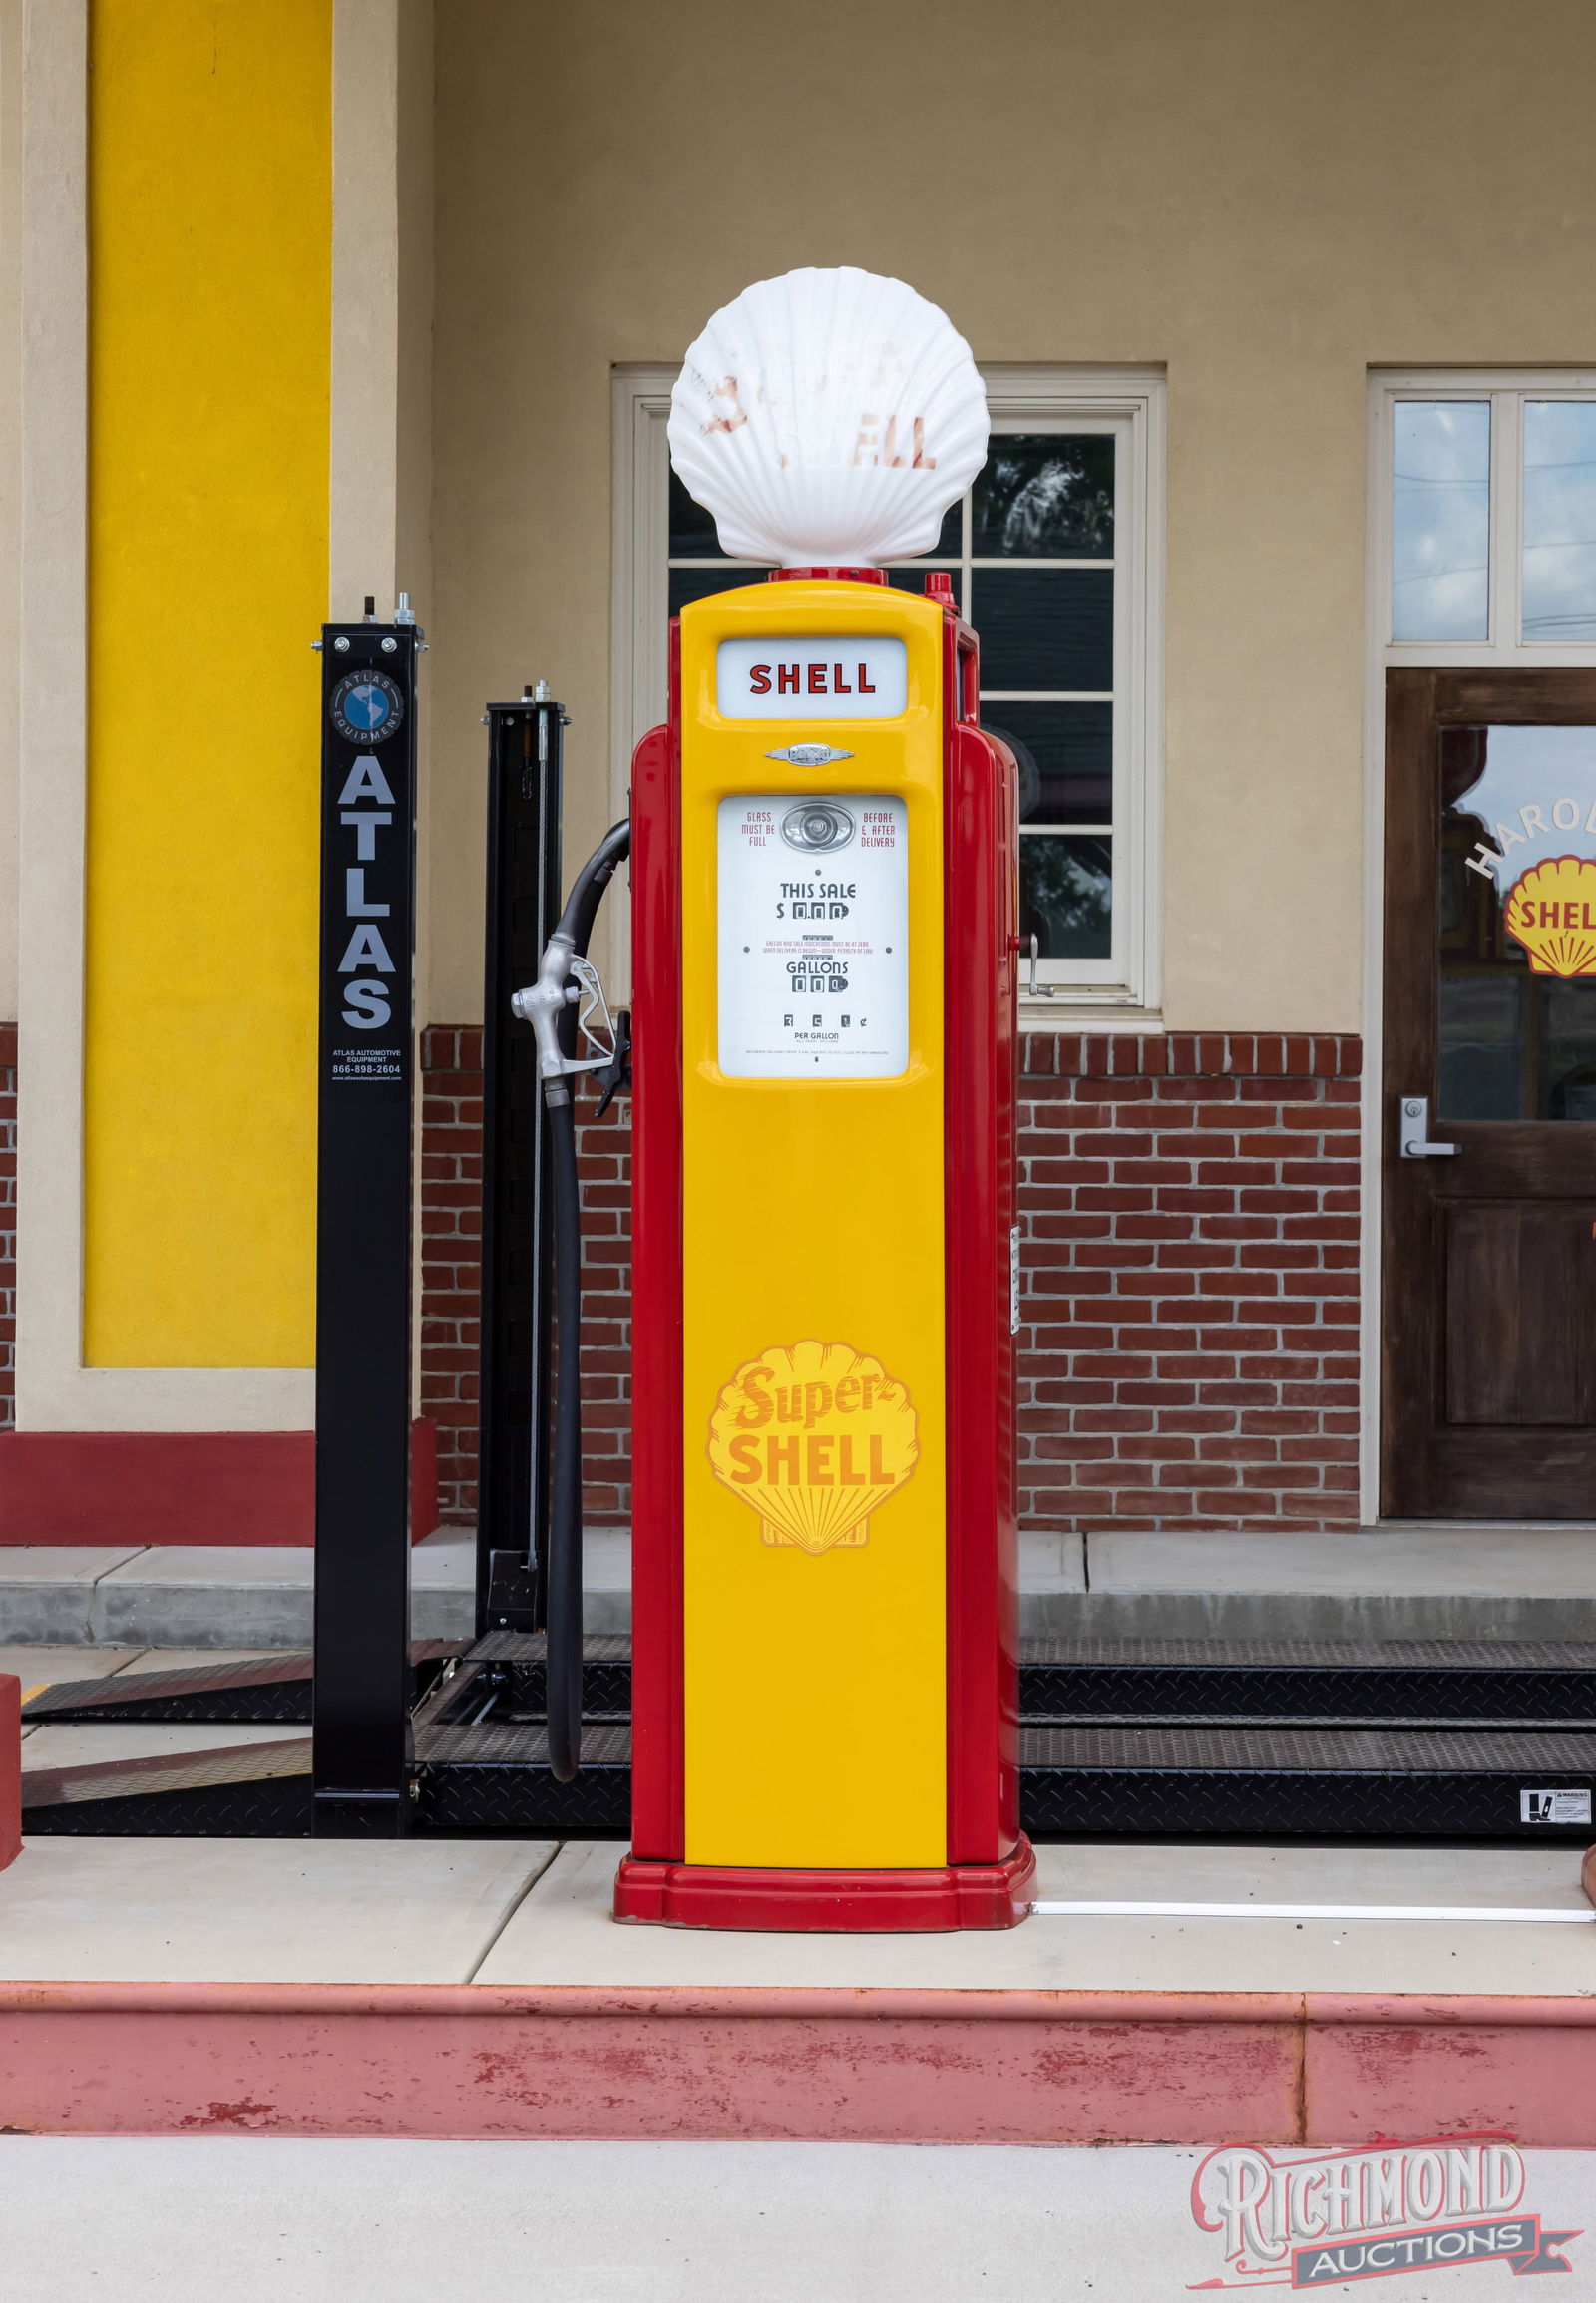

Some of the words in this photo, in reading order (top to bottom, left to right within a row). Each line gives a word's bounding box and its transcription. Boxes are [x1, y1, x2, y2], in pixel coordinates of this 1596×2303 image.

[344, 673, 390, 689] ATLAS
[750, 663, 876, 694] SHELL
[334, 710, 399, 741] EQUIPMENT
[747, 812, 772, 822] GLASS
[863, 813, 893, 823] BEFORE
[741, 825, 762, 835] MUST
[766, 825, 775, 835] BE
[872, 826, 896, 836] AFTER
[749, 837, 767, 847] FULL
[861, 837, 896, 847] DELIVERY
[337, 755, 396, 1030] ATLAS
[780, 883, 814, 898] THIS
[819, 883, 856, 898] SALE
[776, 902, 785, 920] $
[786, 961, 849, 974] GALLONS
[728, 1434, 895, 1485] SHELL
